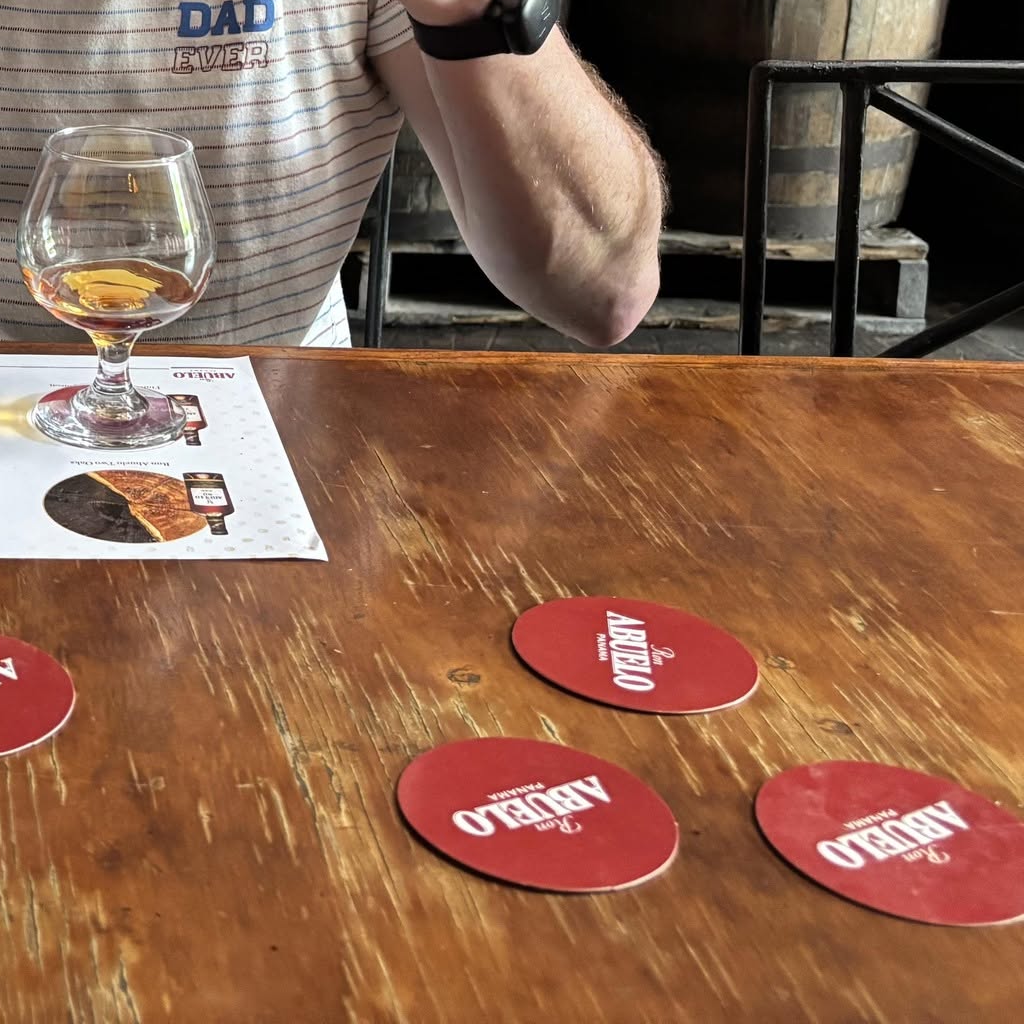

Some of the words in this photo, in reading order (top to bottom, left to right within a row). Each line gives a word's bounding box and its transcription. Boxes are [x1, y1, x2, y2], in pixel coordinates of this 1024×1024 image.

[172, 40, 269, 75] EVER
[173, 372, 235, 380] ABUELO
[596, 633, 609, 661] PANAMA
[606, 610, 656, 692] ABUELO
[651, 644, 675, 666] Ron
[487, 782, 546, 801] PANAMA
[452, 775, 612, 837] ABUELO
[534, 814, 583, 834] Ron
[843, 808, 899, 830] PANAMA
[816, 800, 970, 869] ABUELO
[901, 843, 951, 864] Ron
